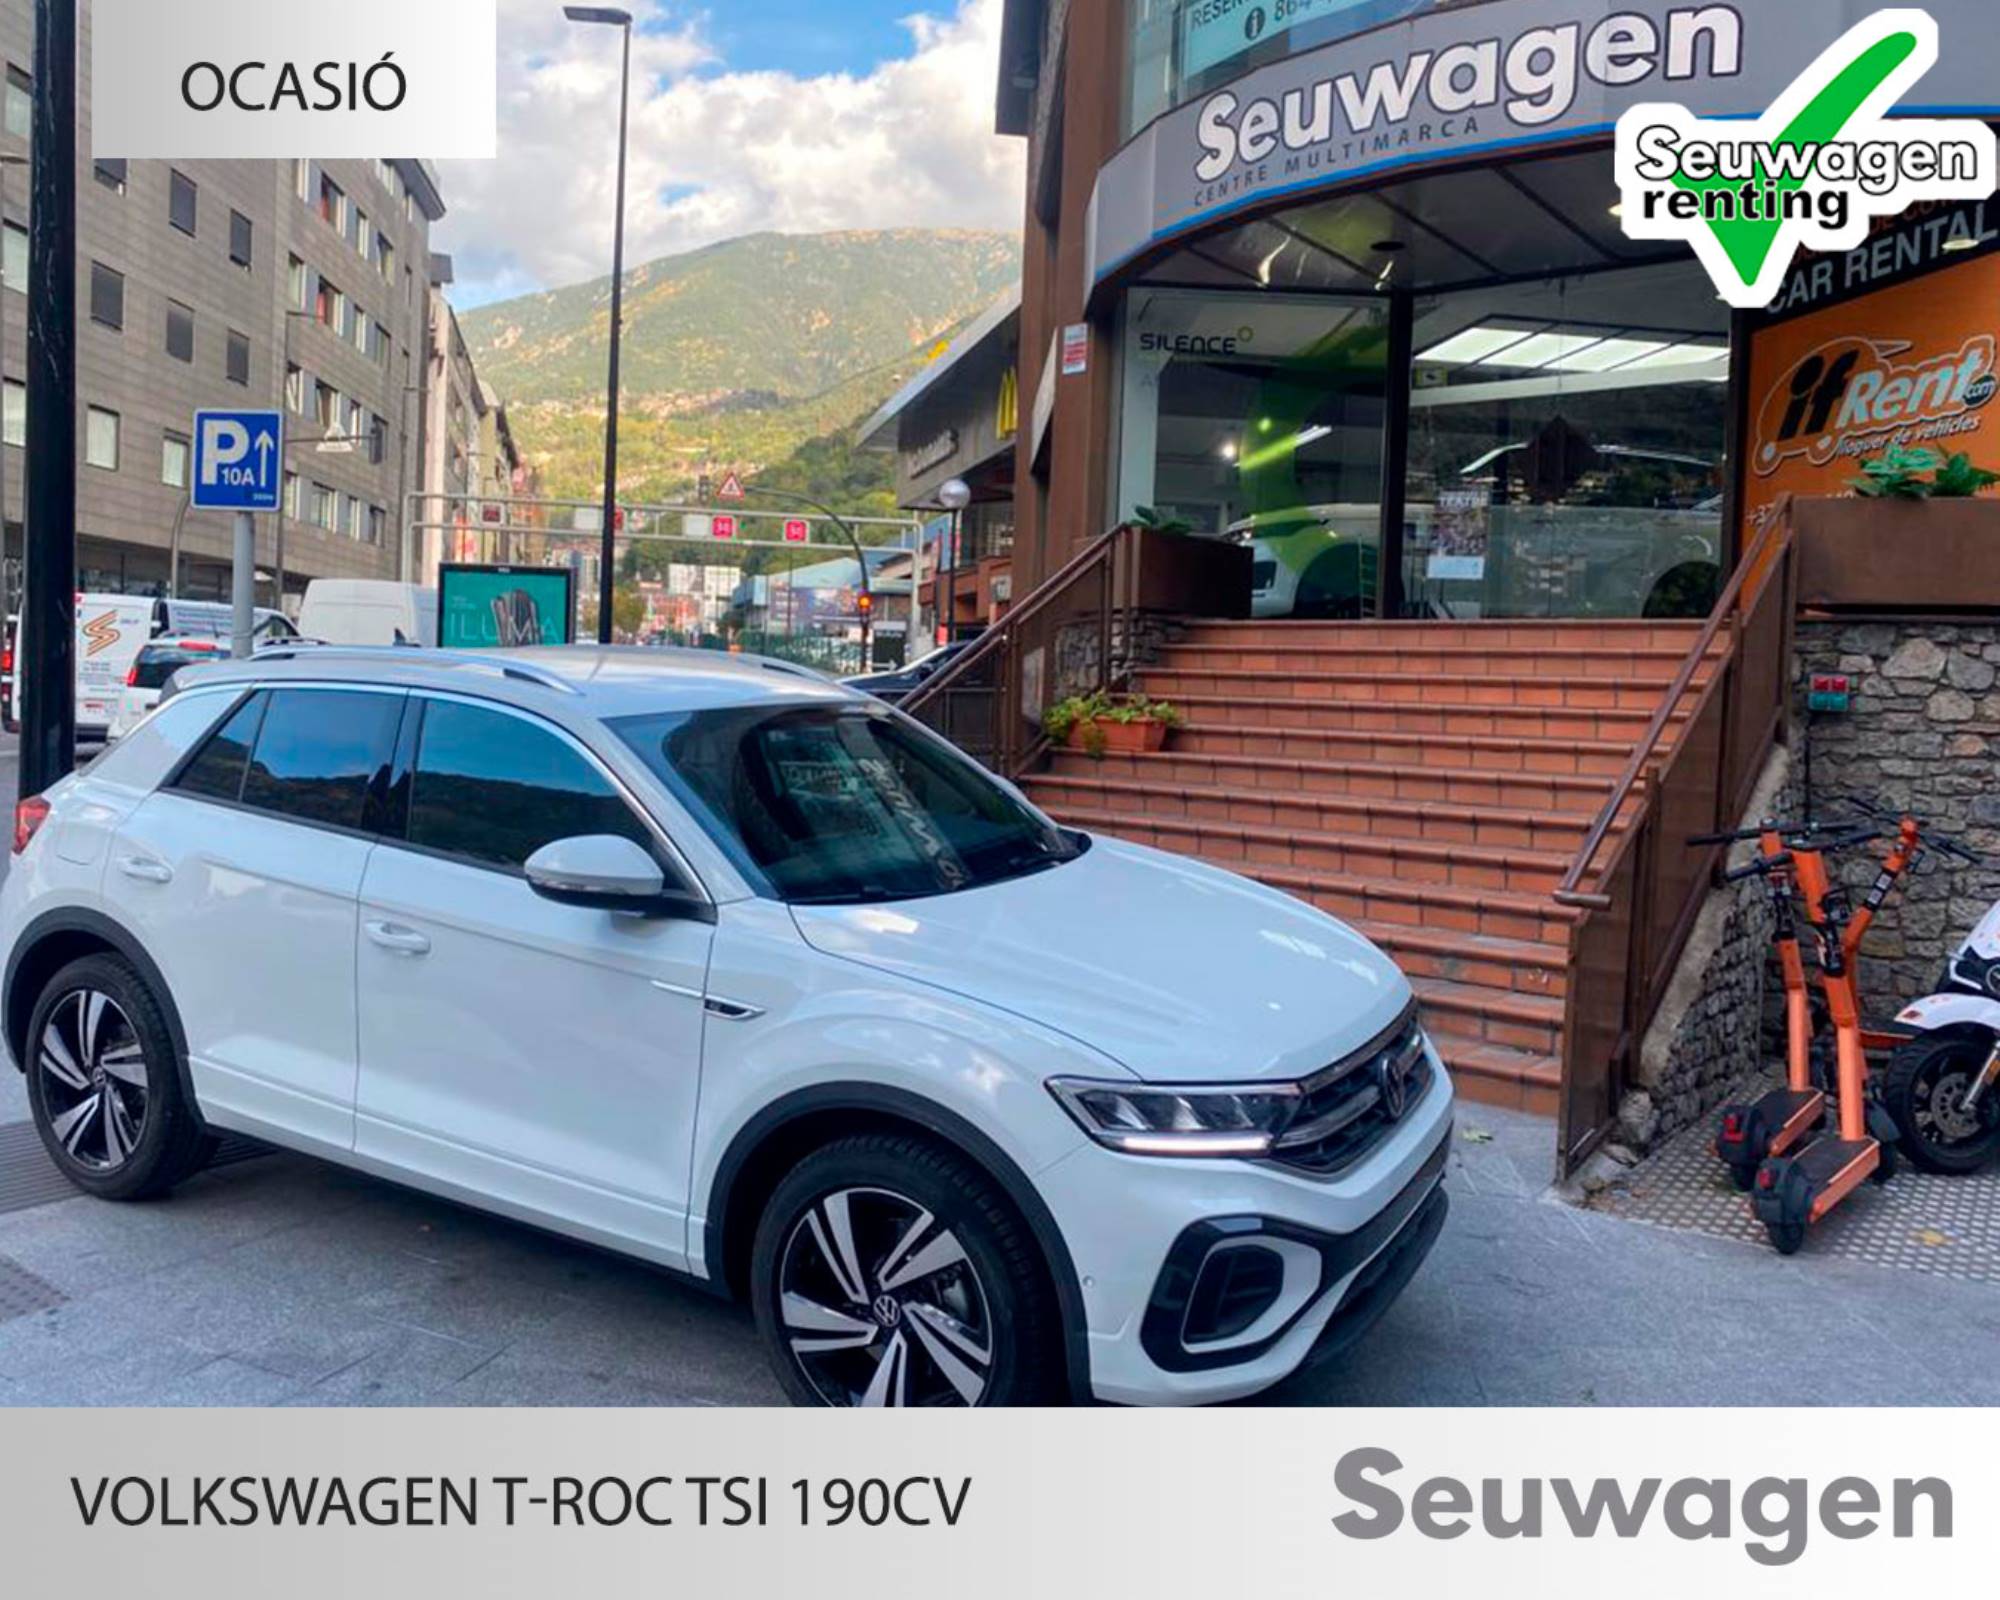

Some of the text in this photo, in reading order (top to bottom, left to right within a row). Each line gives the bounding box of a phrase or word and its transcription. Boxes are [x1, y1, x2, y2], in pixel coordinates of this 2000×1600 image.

[1194, 3, 1743, 183] Seuwagen
[1194, 116, 1479, 207] CENTRE MULTIMARCA
[1844, 202, 1999, 289] RENTAL
[1139, 333, 1237, 355] SILENCE
[202, 419, 249, 485] P
[221, 467, 255, 486] 10A
